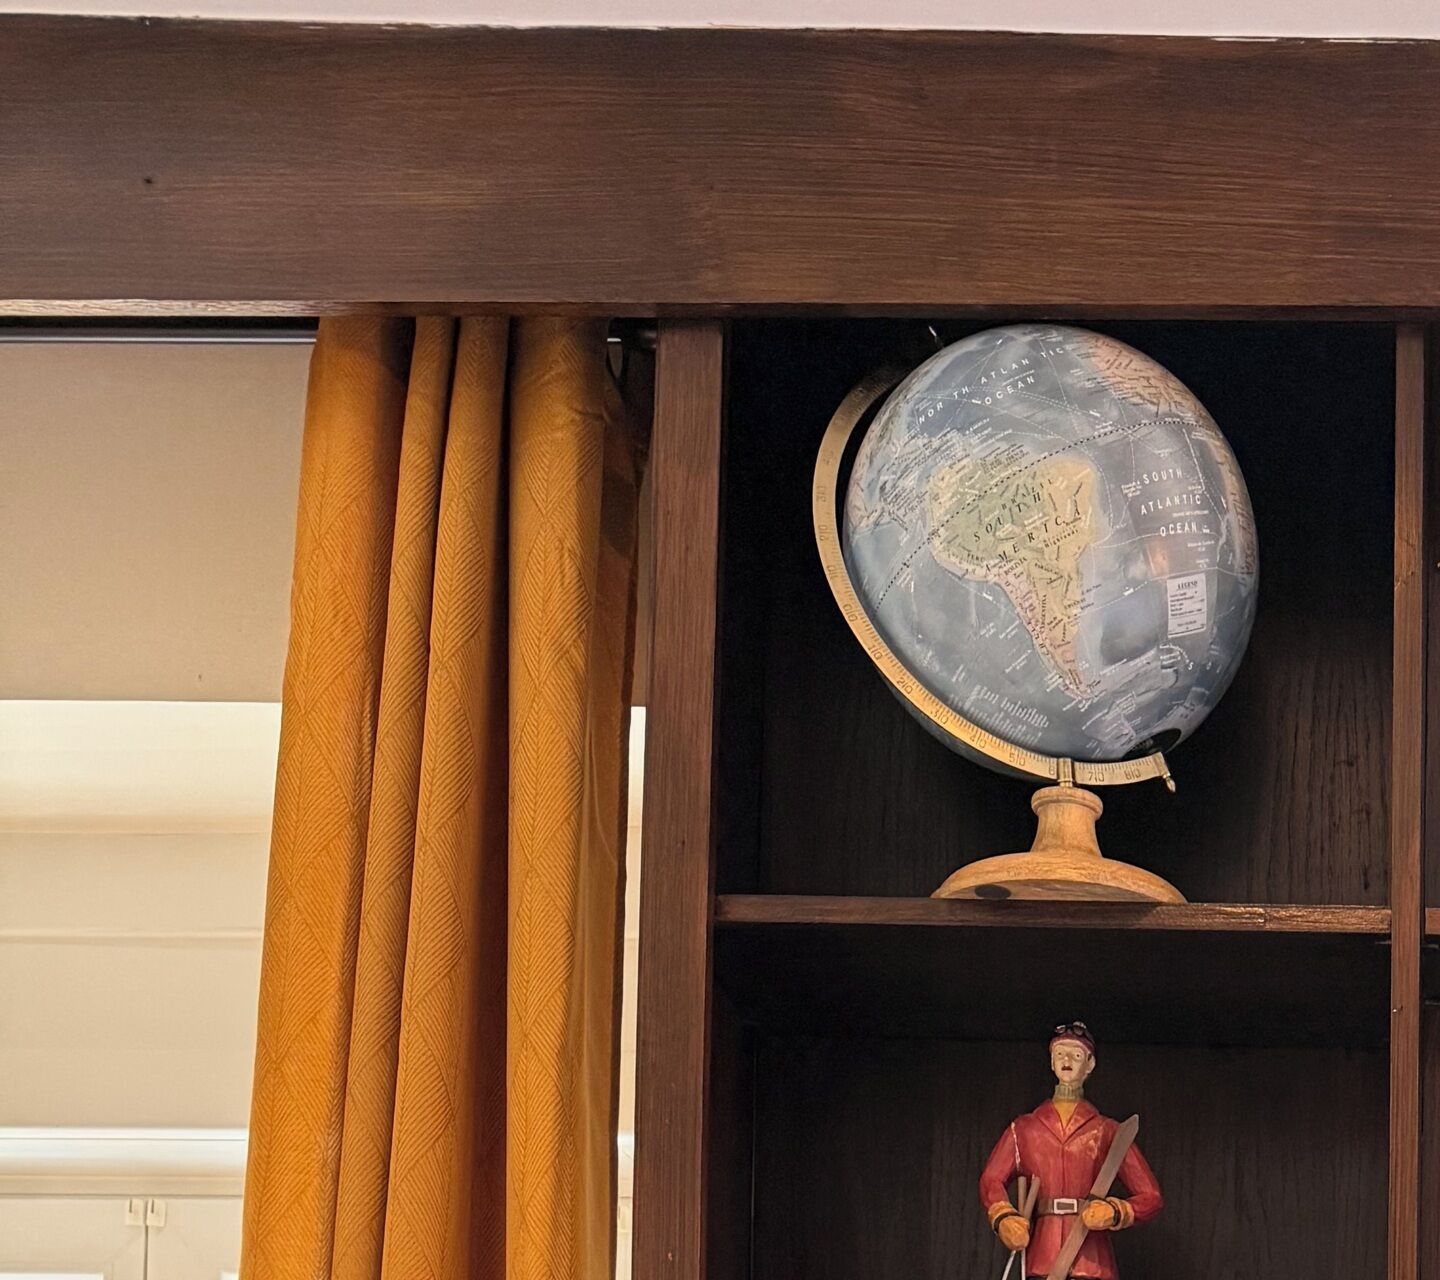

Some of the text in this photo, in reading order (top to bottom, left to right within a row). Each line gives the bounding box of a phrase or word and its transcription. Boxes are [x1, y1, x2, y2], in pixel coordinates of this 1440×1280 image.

[980, 347, 1064, 385] ATLANTIC
[984, 376, 1035, 405] OCEAN
[1142, 468, 1184, 485] SOUTH
[1140, 495, 1202, 516] ATLANTIC
[1159, 522, 1198, 538] OCEAN
